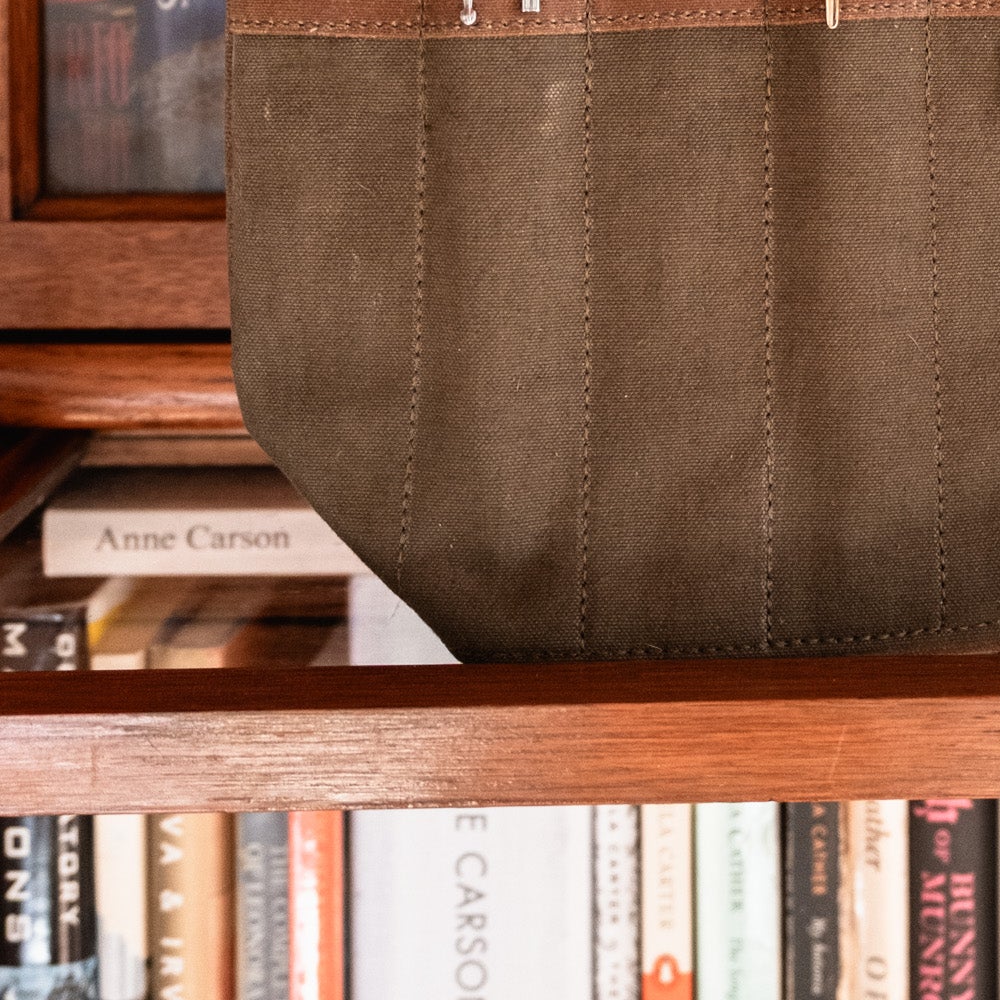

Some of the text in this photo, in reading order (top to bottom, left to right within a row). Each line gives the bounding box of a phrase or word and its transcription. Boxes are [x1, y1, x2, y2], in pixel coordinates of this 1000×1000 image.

[96, 524, 291, 551] Anne Carson
[811, 824, 828, 896] CATHER
[455, 851, 488, 1000] CARSO
